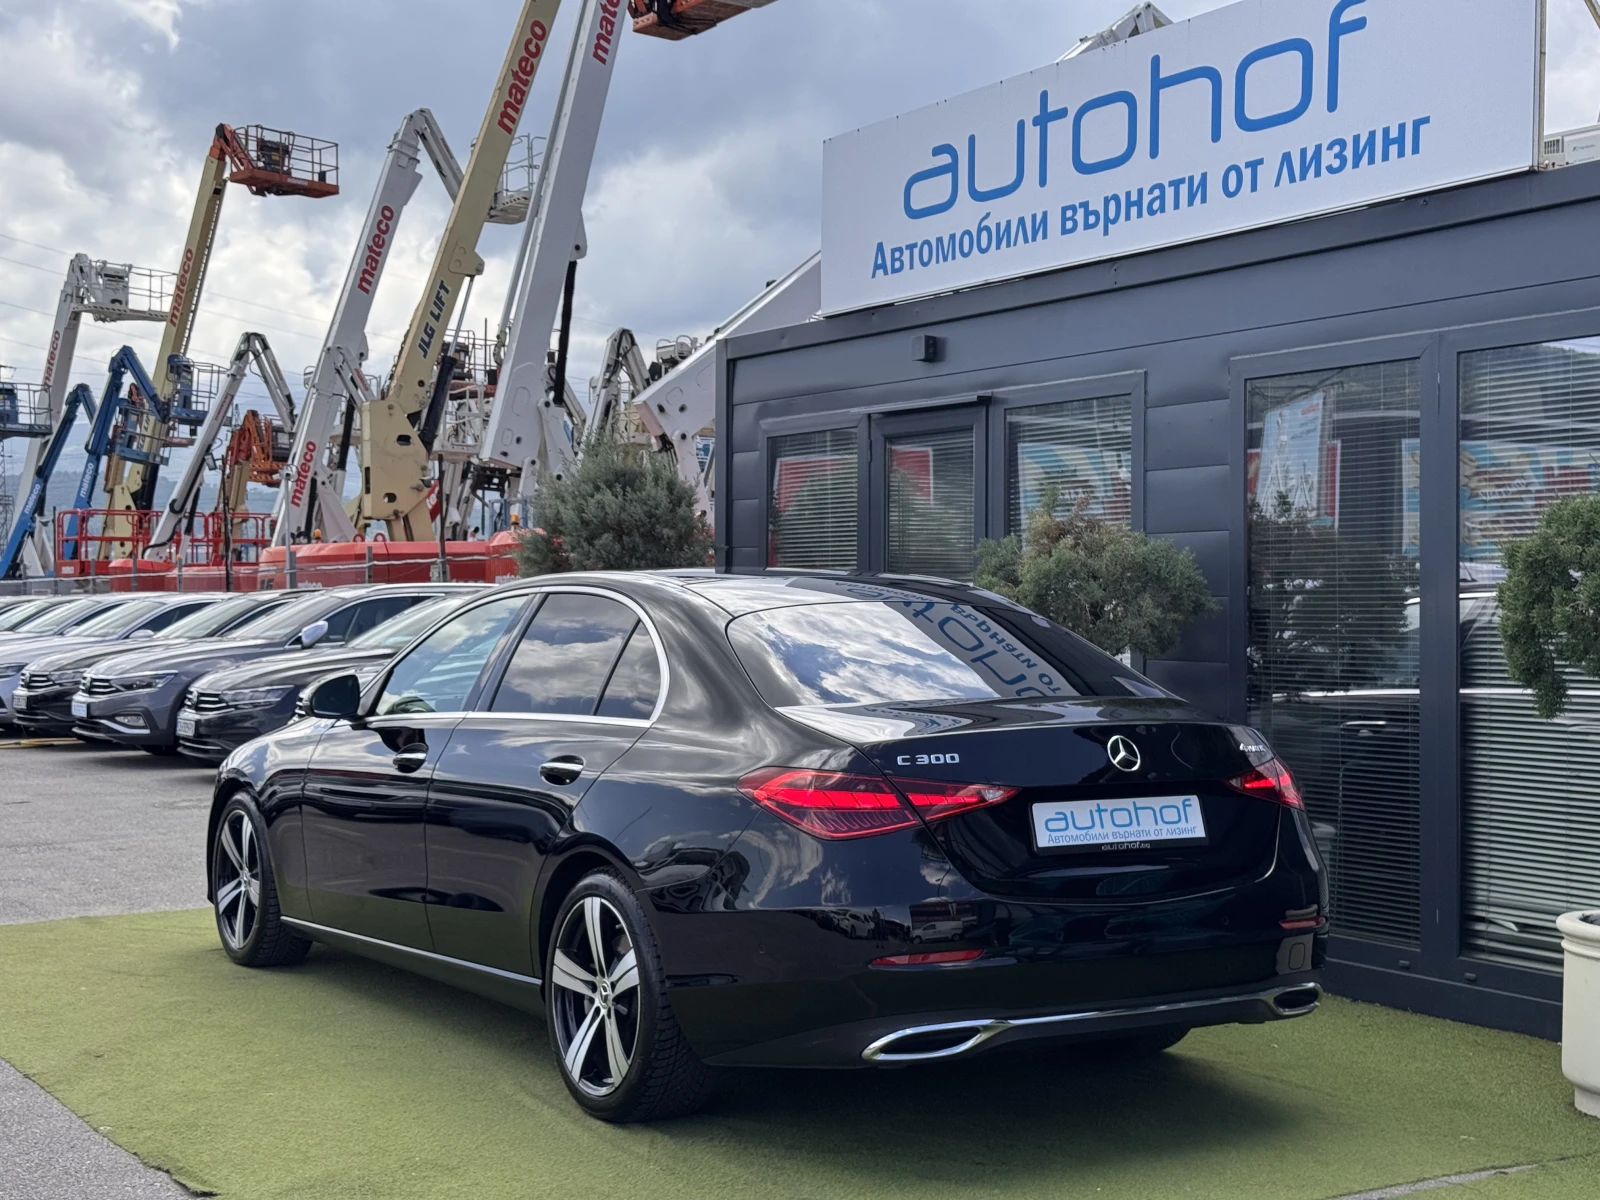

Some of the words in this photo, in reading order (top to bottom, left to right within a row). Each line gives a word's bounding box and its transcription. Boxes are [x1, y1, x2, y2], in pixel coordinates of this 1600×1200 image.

[497, 19, 547, 135] mateco
[903, 0, 1368, 219] autohof
[871, 210, 1048, 279] Автомобили
[1060, 171, 1208, 237] върнати
[1221, 157, 1265, 199] от
[1274, 115, 1431, 188] лизинг
[357, 205, 395, 294] mateco
[169, 248, 194, 328] mateco
[417, 321, 436, 359] JLG
[429, 279, 450, 323] LIFT
[24, 483, 41, 514] mateco
[79, 462, 95, 498] mateco
[290, 440, 317, 508] mateco
[897, 755, 911, 766] C
[915, 753, 960, 765] 300
[1044, 798, 1193, 833] autohof
[1047, 830, 1109, 845] Автомобили
[1111, 828, 1152, 840] върнати
[1153, 828, 1164, 838] от
[1165, 826, 1197, 837] лизинг
